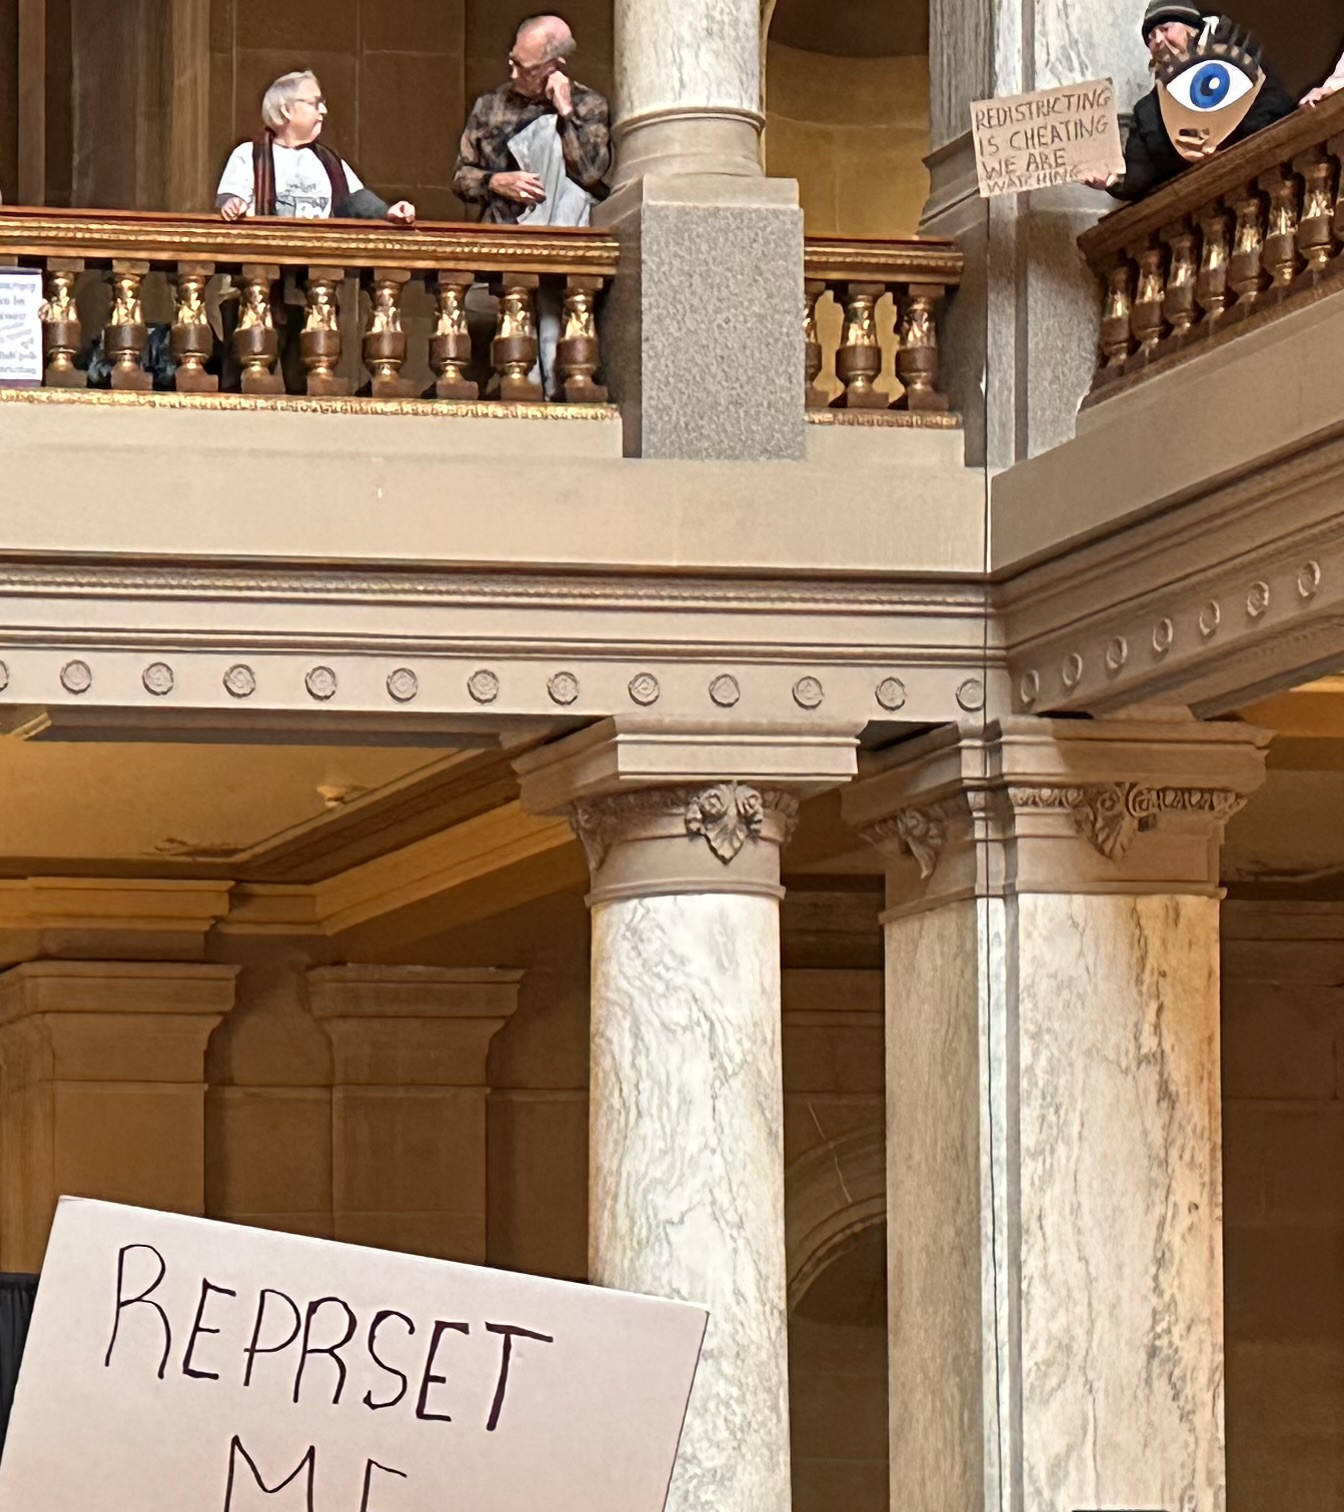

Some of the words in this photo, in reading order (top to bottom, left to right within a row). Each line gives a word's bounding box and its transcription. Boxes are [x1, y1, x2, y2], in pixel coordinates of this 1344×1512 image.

[976, 88, 1111, 131] REDISTRICTING
[980, 135, 999, 156] IS
[1010, 114, 1109, 152] CHEATING
[982, 156, 1016, 180] WE
[1026, 148, 1065, 172] ARE
[105, 1244, 553, 1431] REPRSET
